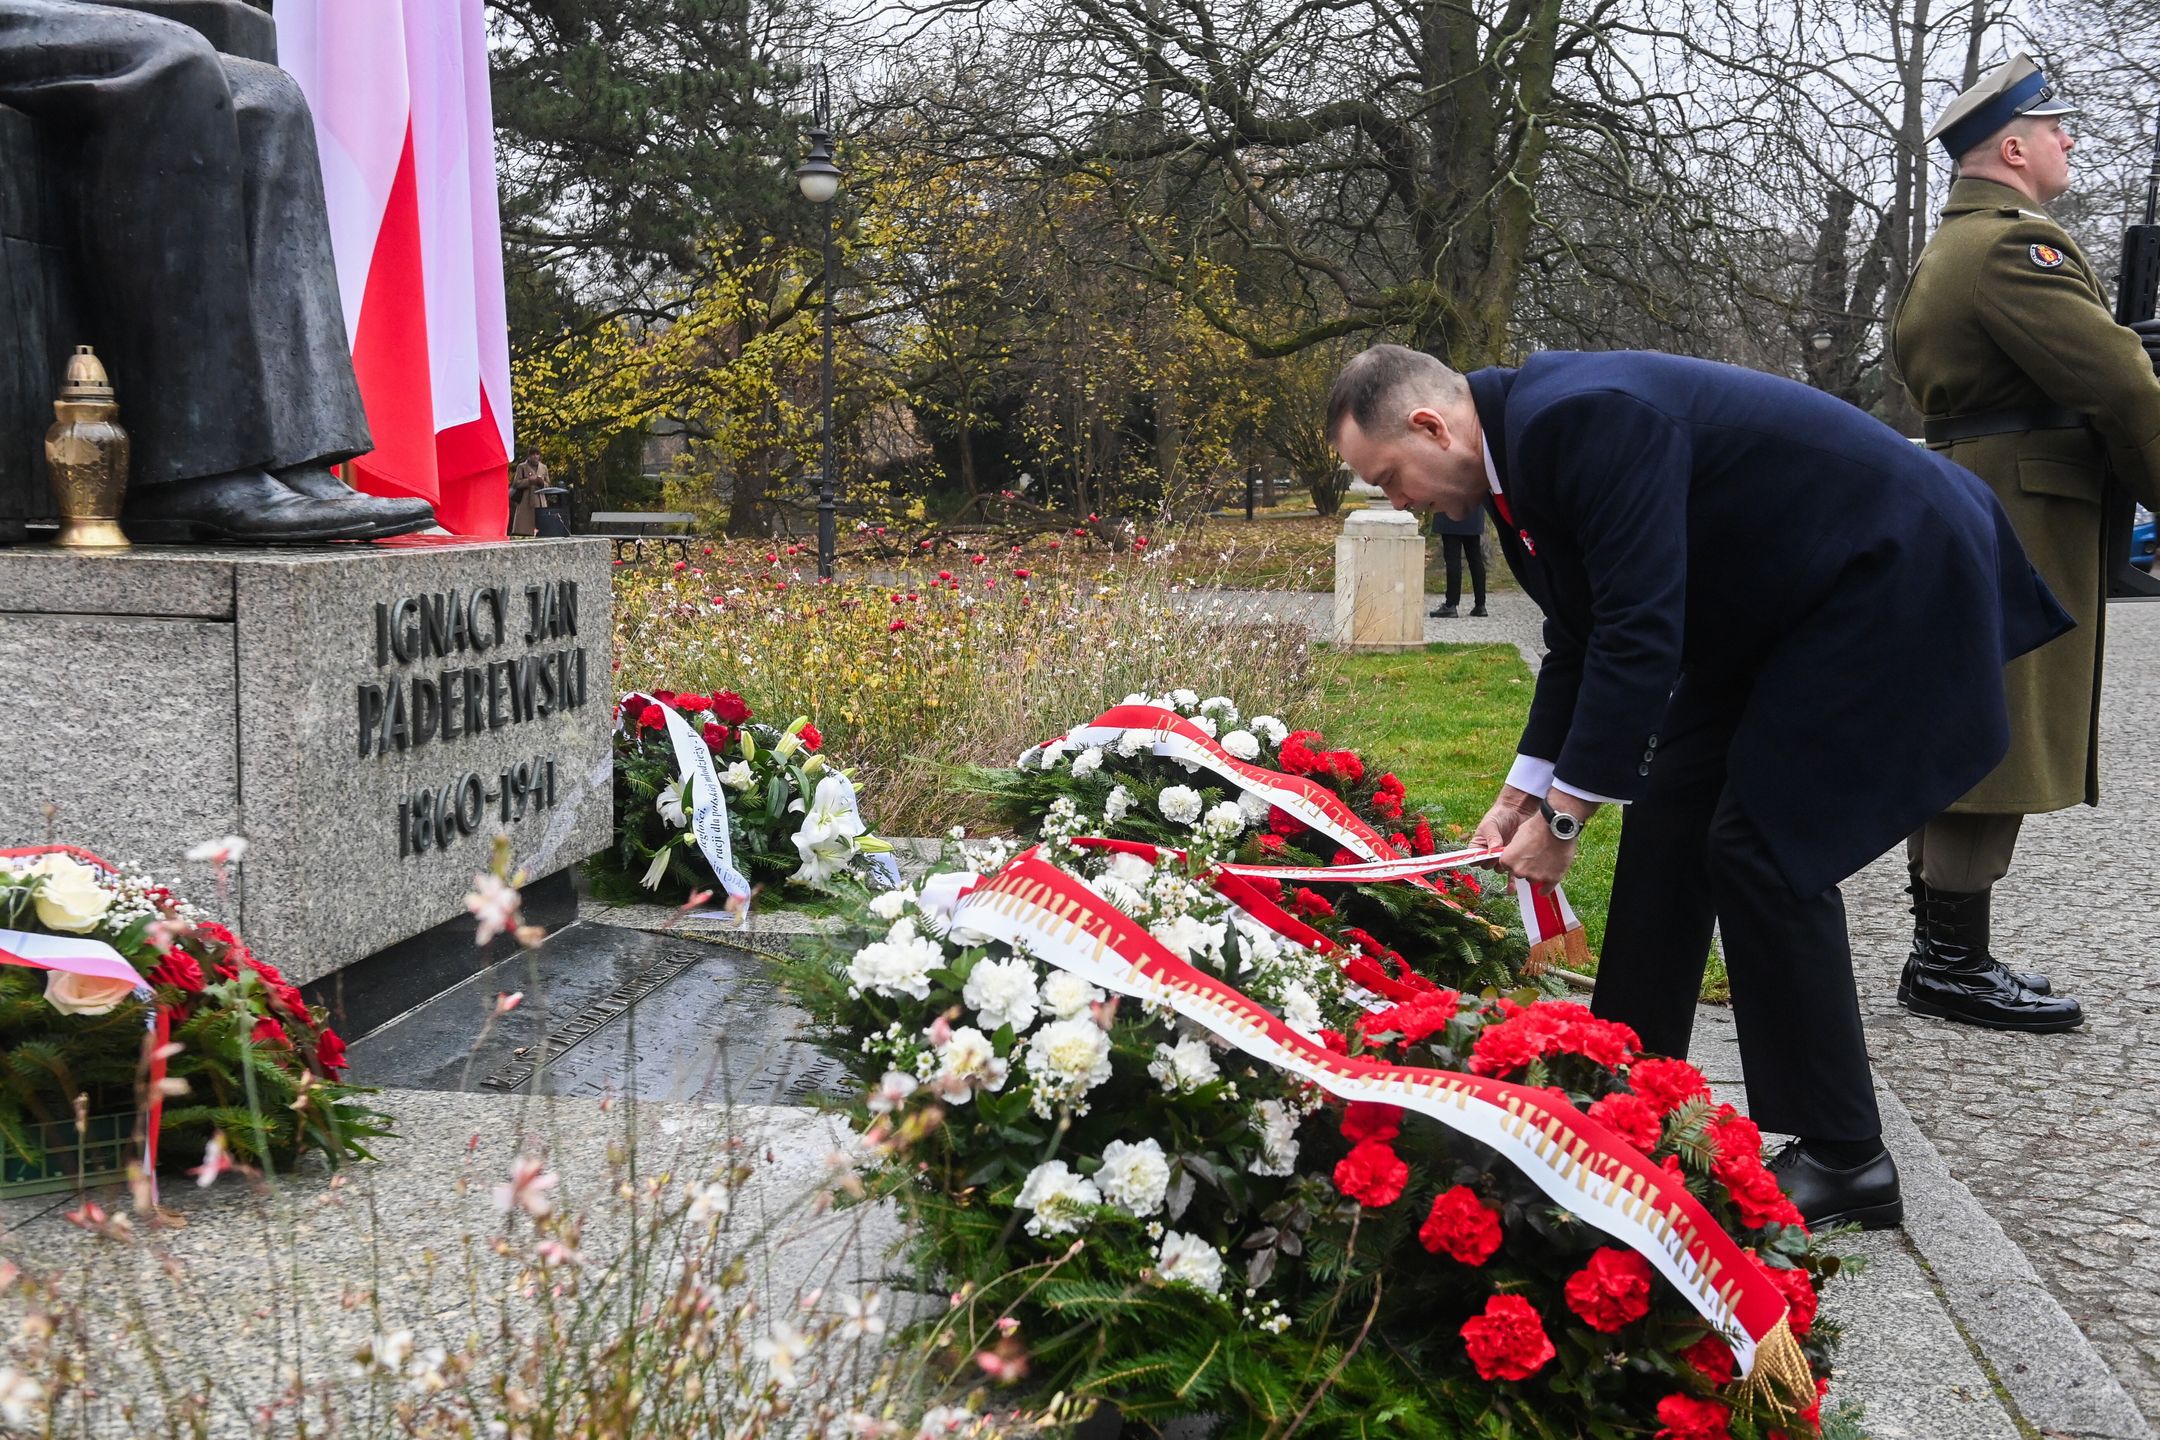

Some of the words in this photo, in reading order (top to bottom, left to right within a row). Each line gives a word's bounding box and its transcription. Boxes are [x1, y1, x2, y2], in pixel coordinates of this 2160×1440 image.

[375, 586, 510, 668] IGNACY
[525, 580, 577, 643] JAN
[358, 646, 587, 758] PADEREWSKI
[1150, 714, 1180, 744] RP
[399, 753, 555, 859] 1860-1941
[1185, 734, 1283, 795] SENATU
[1116, 951, 1270, 1039] OBRONY
[1273, 1036, 1483, 1112] MINISTER
[1496, 1088, 1744, 1329] WICEPREMIER,
